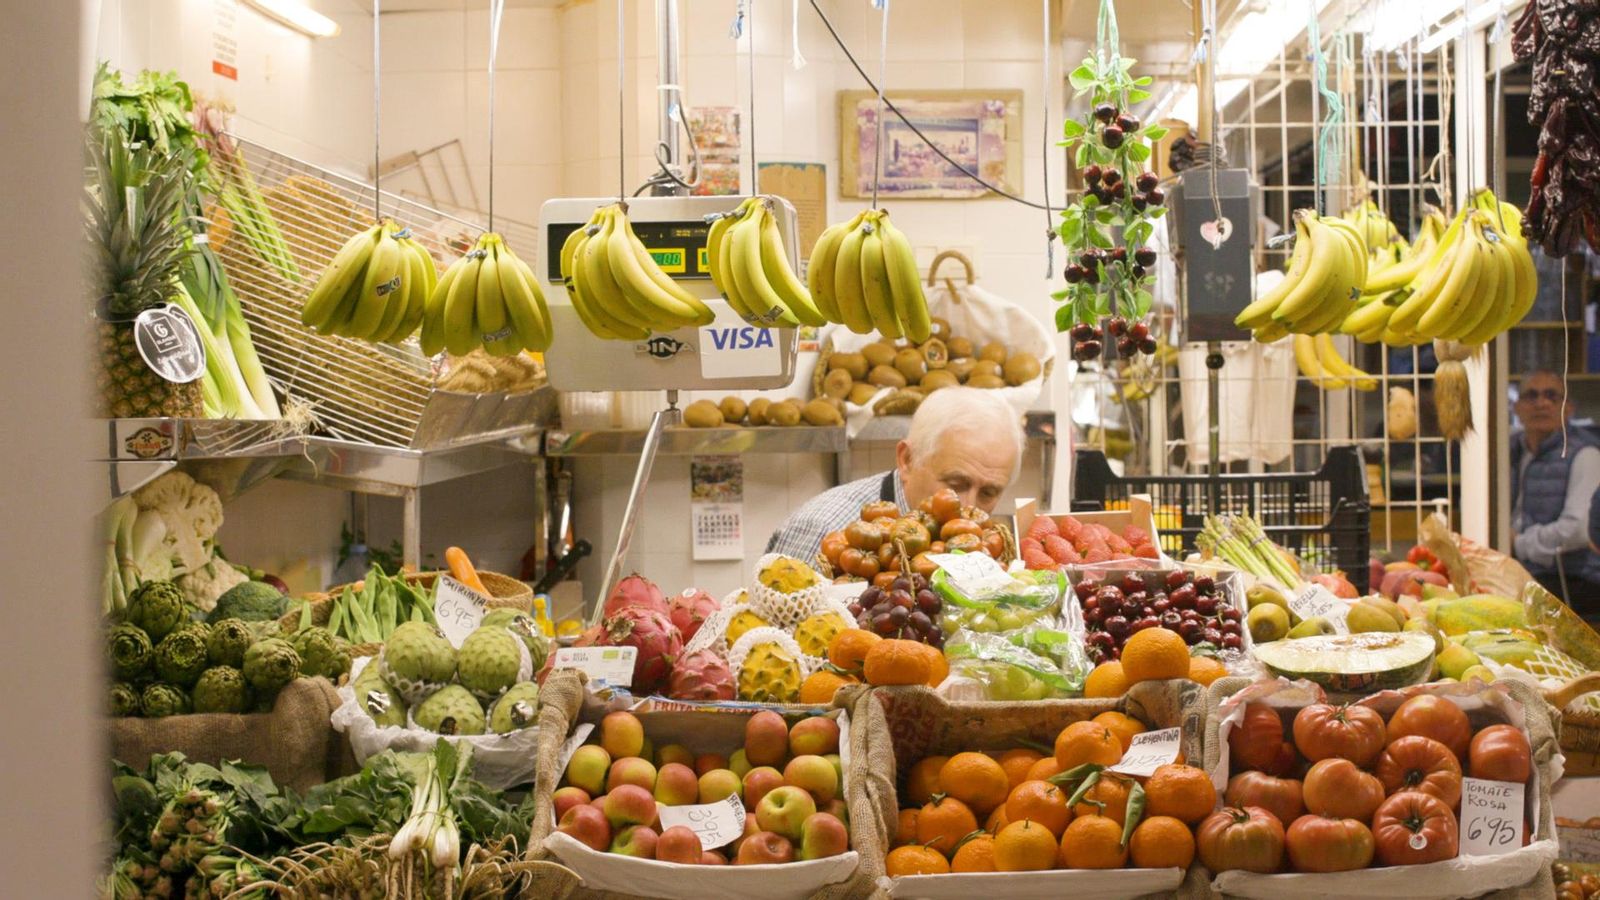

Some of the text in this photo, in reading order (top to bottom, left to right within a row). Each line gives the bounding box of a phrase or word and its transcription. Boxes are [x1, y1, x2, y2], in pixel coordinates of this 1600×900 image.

[634, 339, 695, 356] DINA
[705, 327, 774, 350] VISA
[438, 600, 475, 628] 6'95
[1132, 729, 1179, 746] CLEMENTINA
[1465, 781, 1514, 797] TOMATE
[1468, 794, 1506, 810] ROSA
[688, 809, 721, 845] 3'95
[1468, 816, 1516, 846] 6'95
